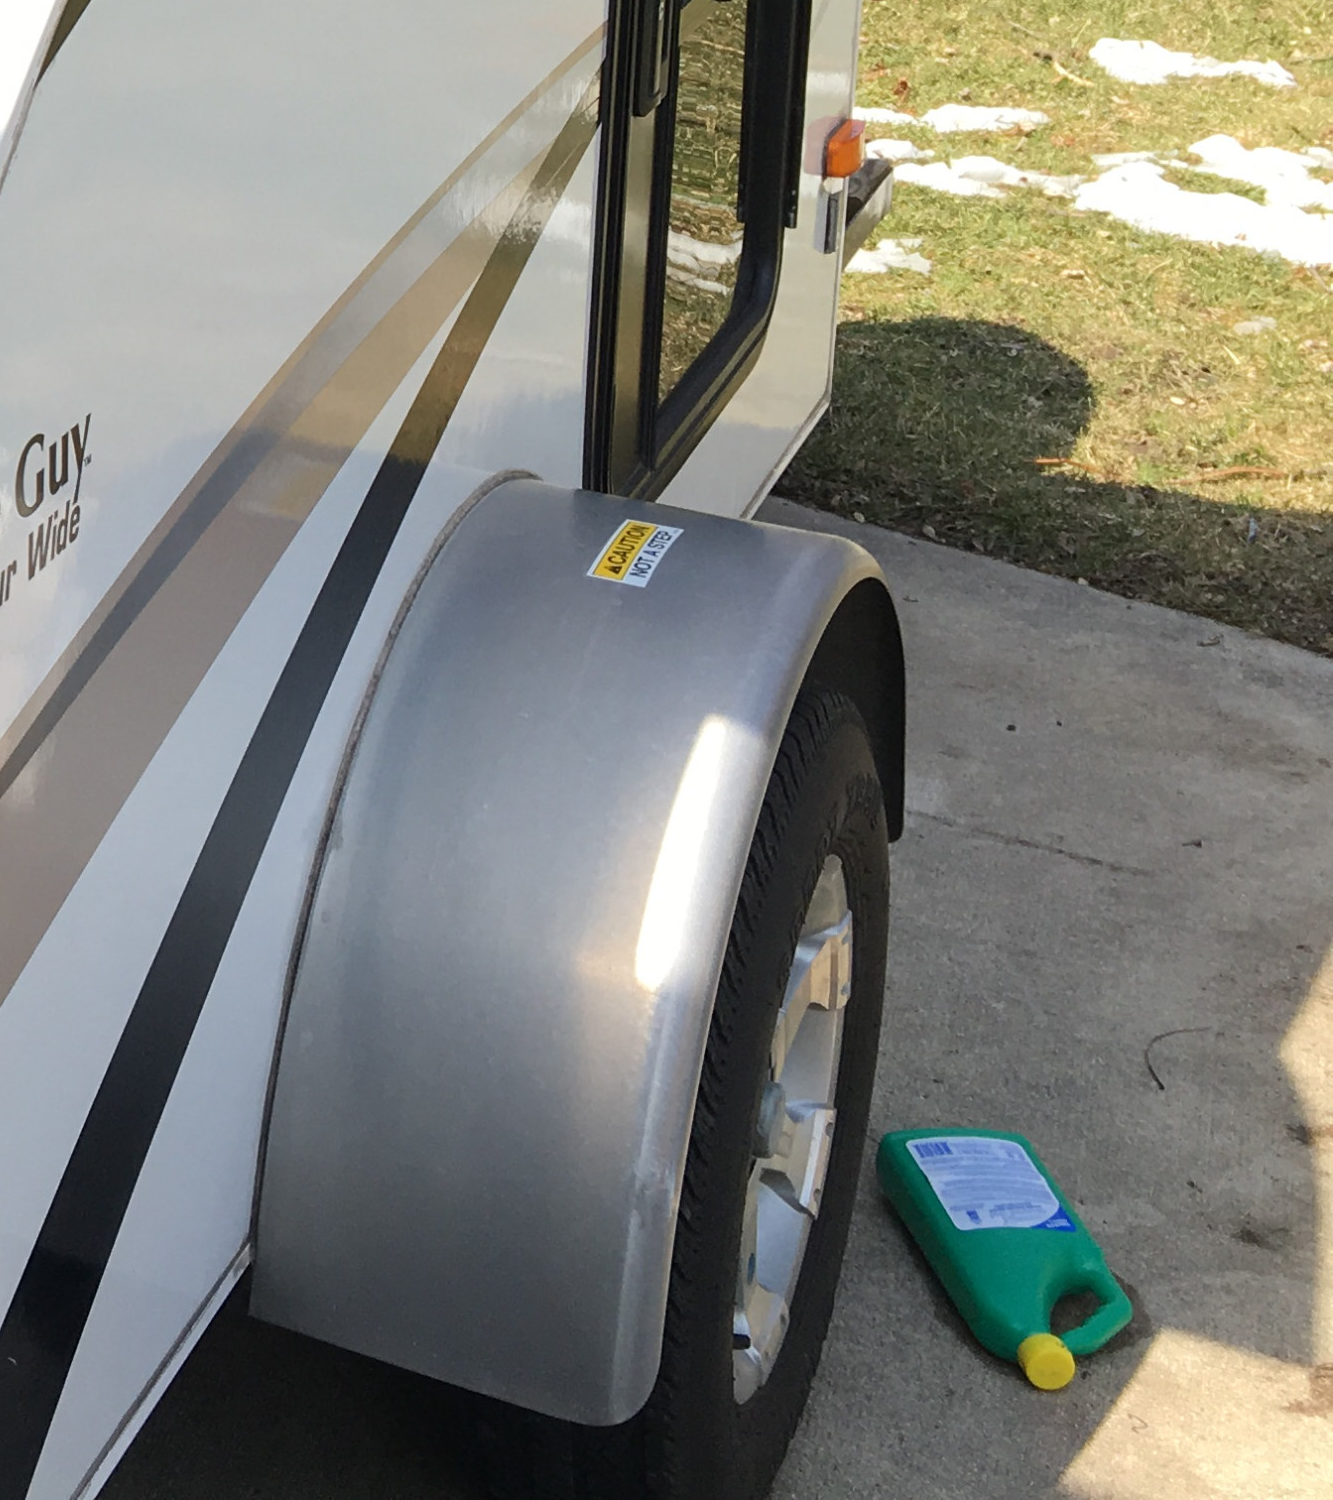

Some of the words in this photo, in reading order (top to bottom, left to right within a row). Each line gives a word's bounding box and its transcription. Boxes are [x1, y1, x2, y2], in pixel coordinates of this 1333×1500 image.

[15, 413, 92, 518] Guy
[28, 498, 81, 581] Wide
[607, 525, 650, 564] CAUTION
[643, 550, 660, 558] A
[647, 530, 673, 549] STEP
[629, 557, 654, 578] NOT
